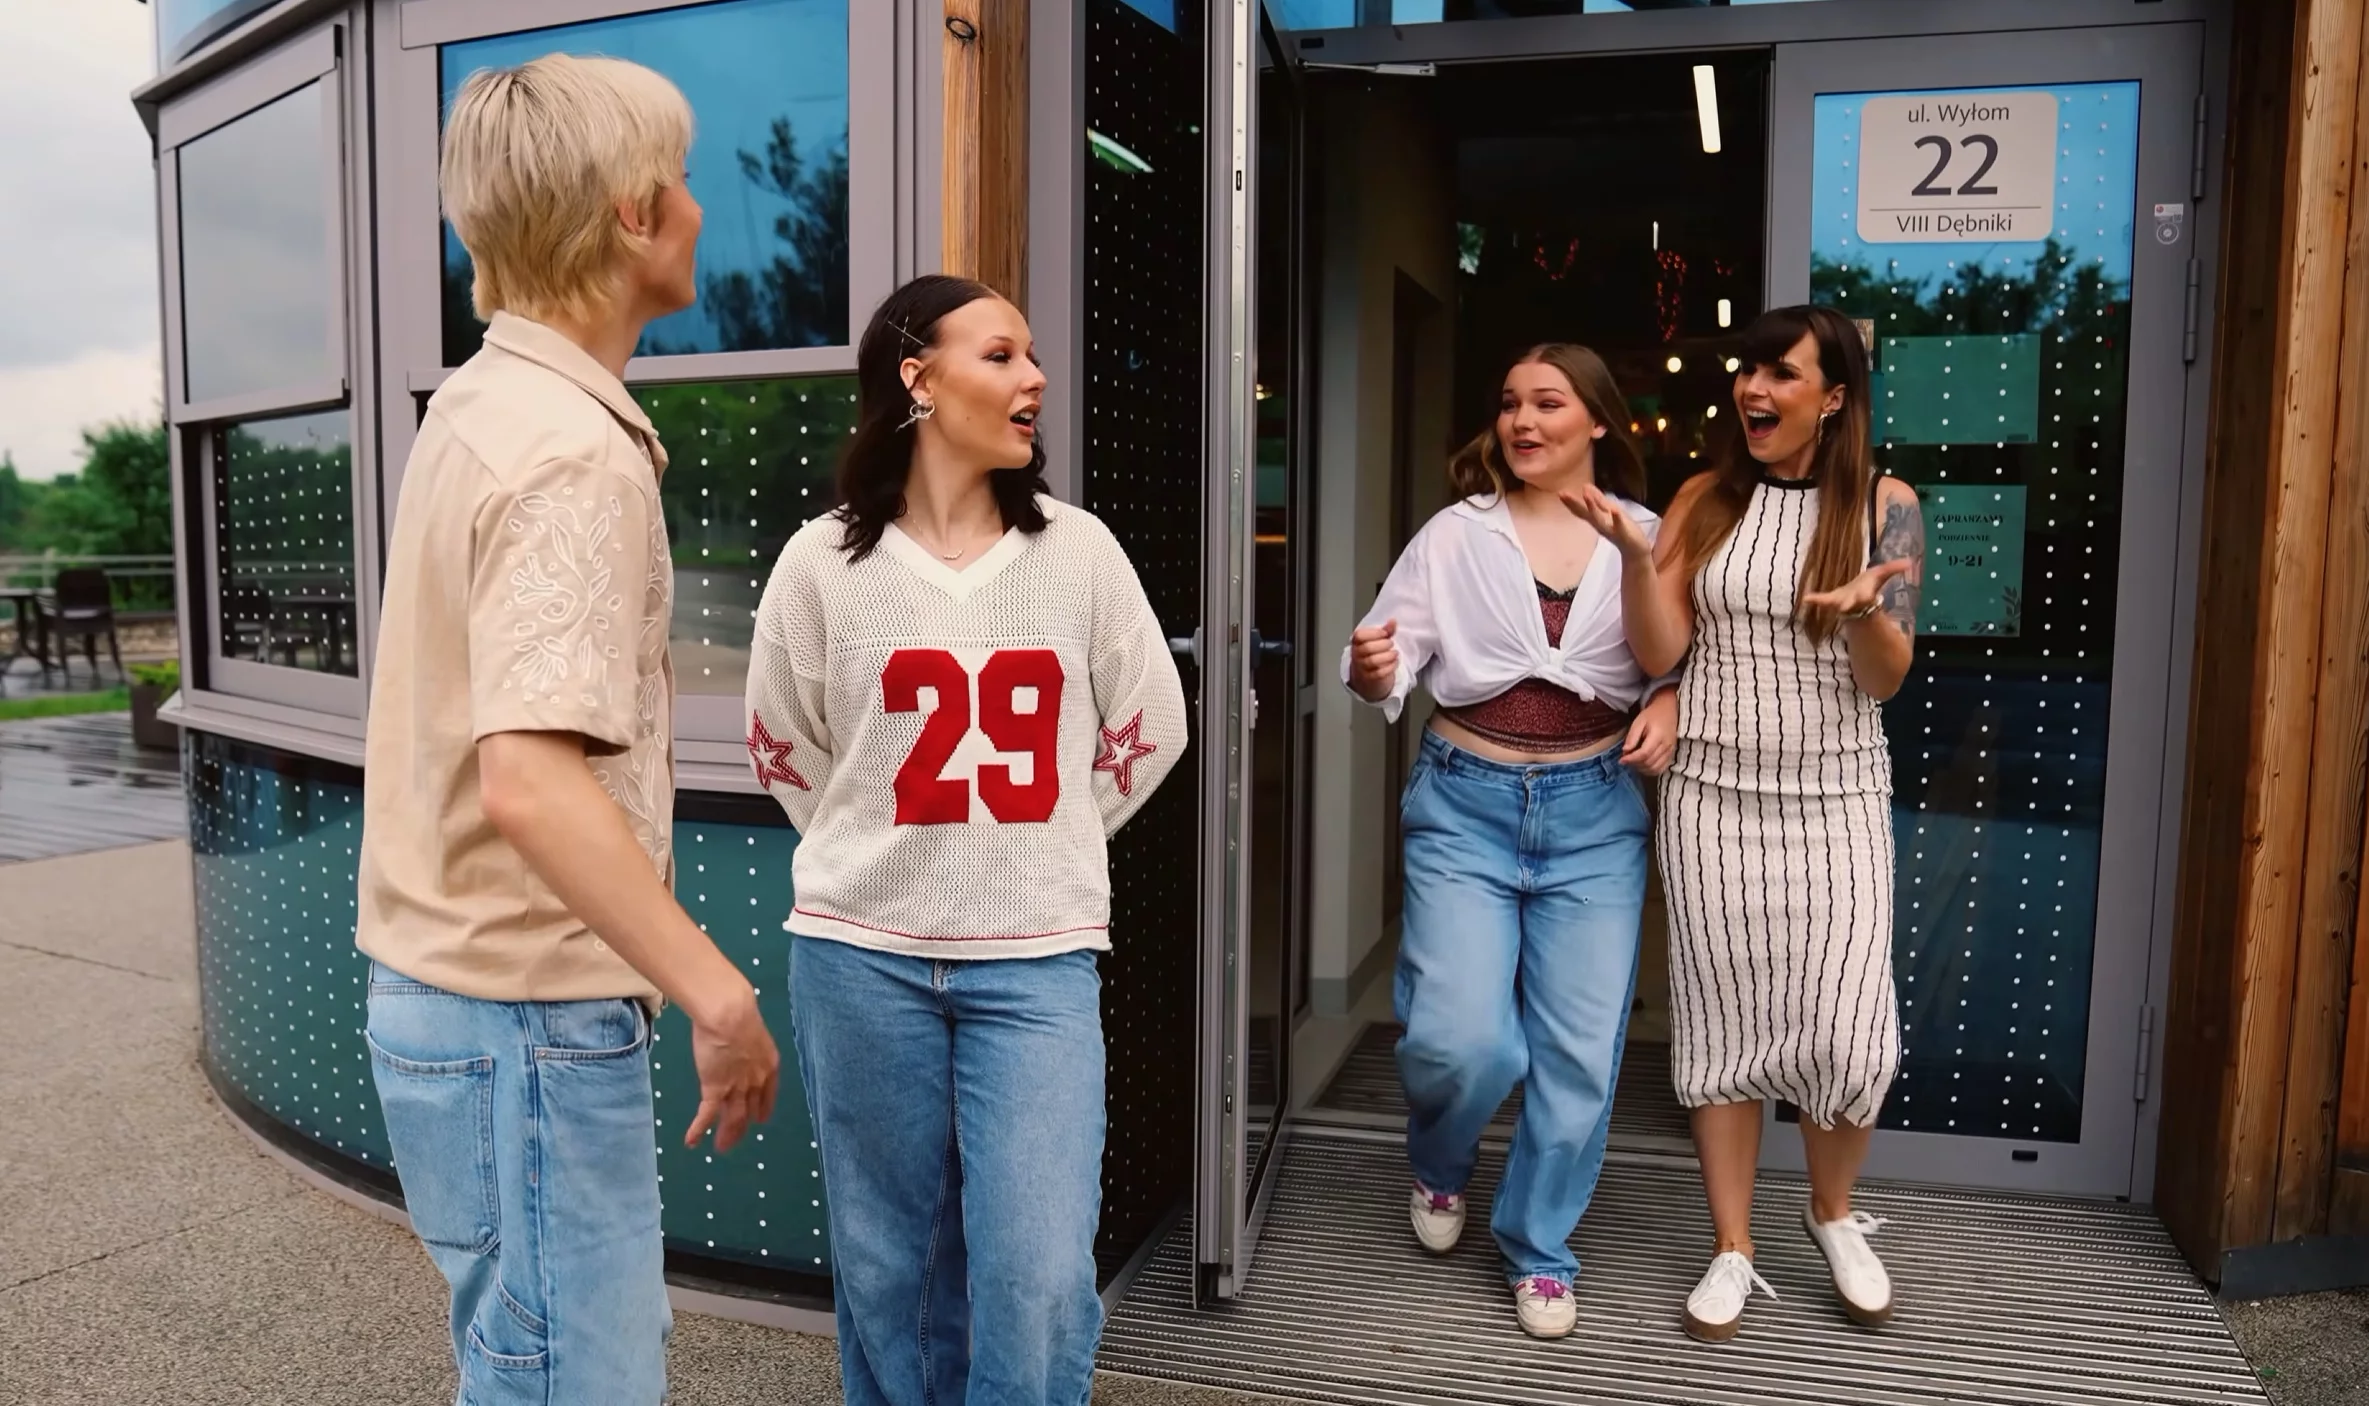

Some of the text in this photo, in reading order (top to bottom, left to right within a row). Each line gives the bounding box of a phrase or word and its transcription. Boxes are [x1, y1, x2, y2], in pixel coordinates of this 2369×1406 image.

[1908, 102, 2010, 127] ul. Wyłom
[1911, 133, 1999, 196] 22
[1896, 213, 2012, 237] VIII Dębniki
[1948, 554, 1983, 567] 9-21
[880, 648, 1065, 826] 29
